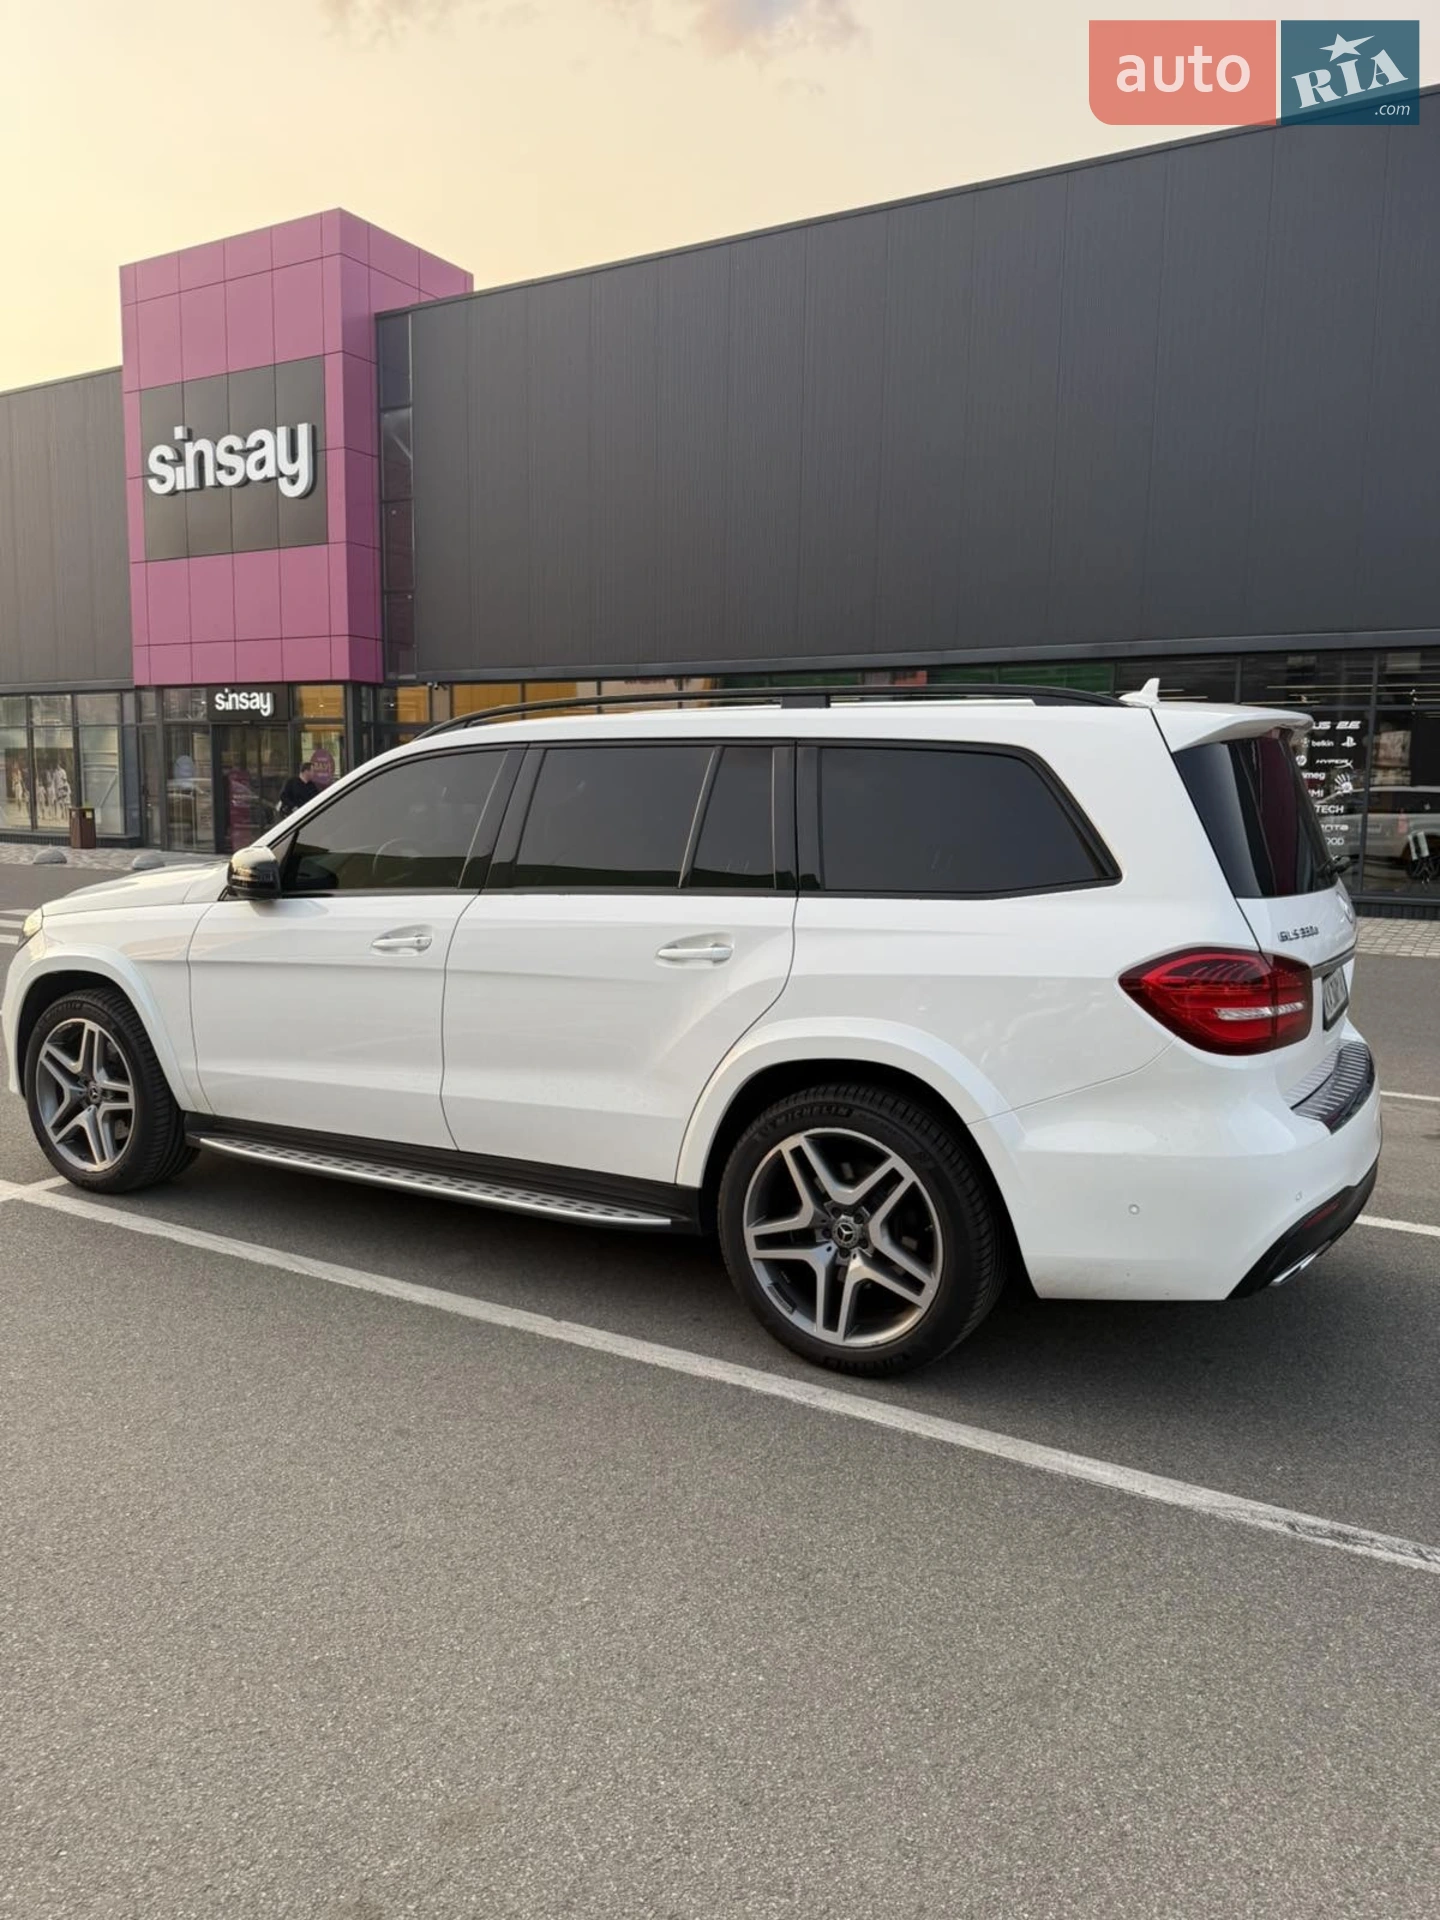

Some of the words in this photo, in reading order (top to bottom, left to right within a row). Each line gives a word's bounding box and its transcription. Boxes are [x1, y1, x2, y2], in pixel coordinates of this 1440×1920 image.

[148, 422, 312, 498] sinsay
[214, 687, 273, 717] sinsay
[1311, 739, 1334, 748] belkin
